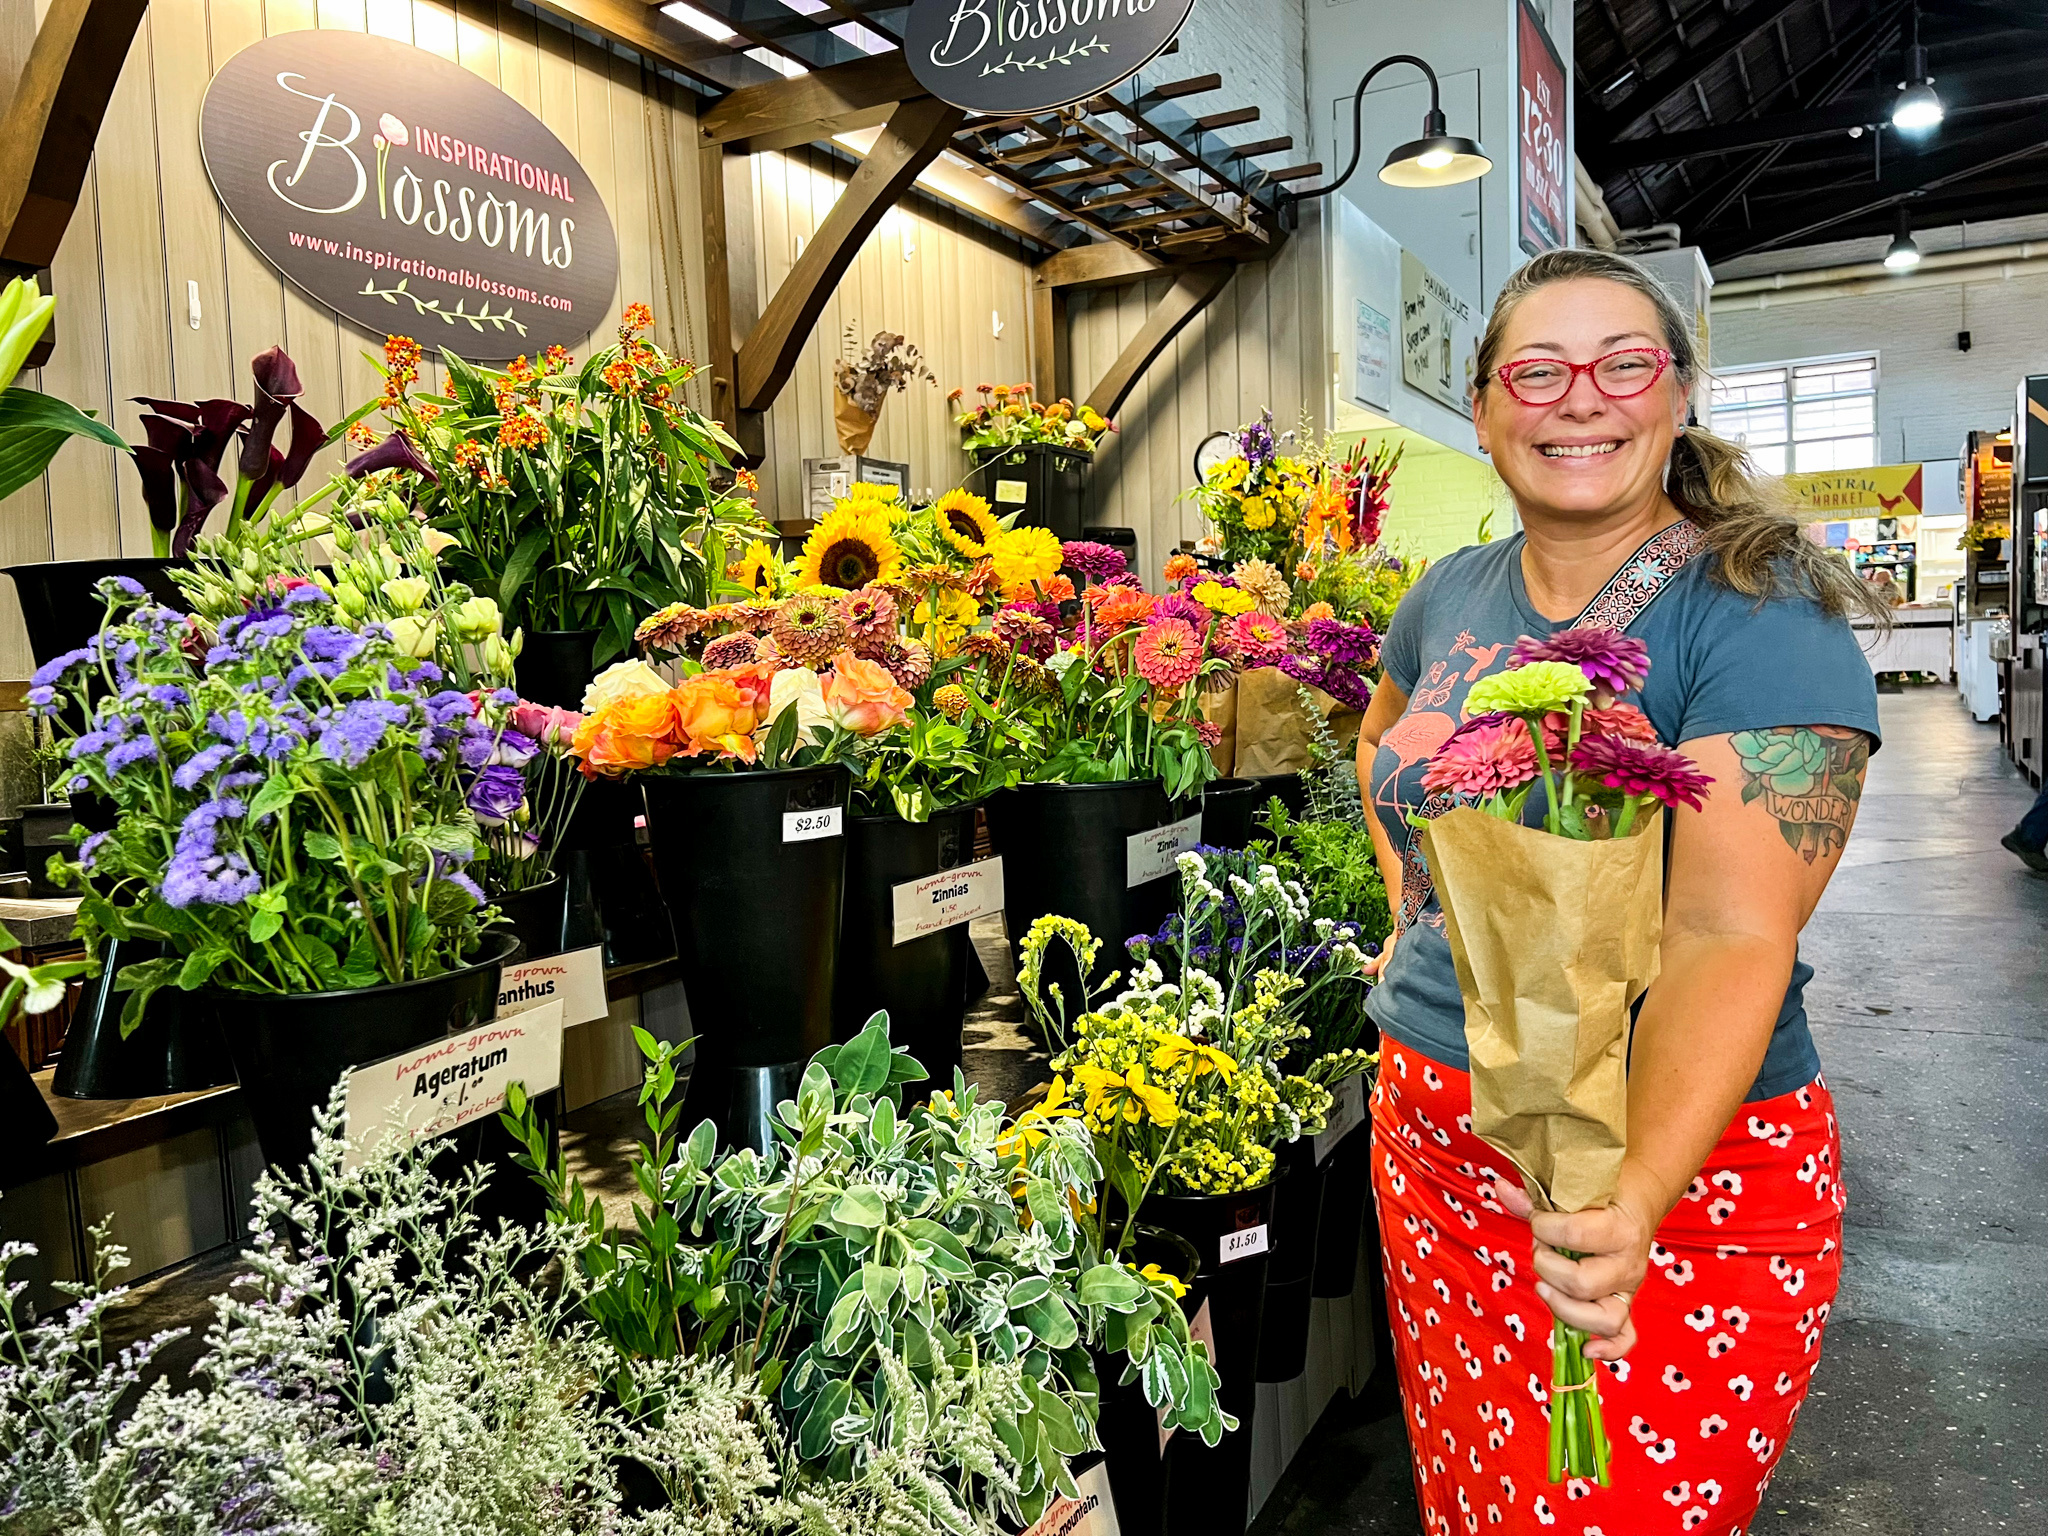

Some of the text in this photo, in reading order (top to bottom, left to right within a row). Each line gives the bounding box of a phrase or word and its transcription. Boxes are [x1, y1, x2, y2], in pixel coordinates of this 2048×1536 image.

[1521, 85, 1563, 187] 1730
[266, 71, 576, 269] Blossoms
[414, 125, 575, 203] INSPIRATIONAL
[288, 231, 572, 312] www.inspirationalblossoms.com
[1800, 478, 1877, 497] CENTRAL
[1812, 491, 1863, 507] MARKET
[1772, 794, 1850, 825] WONDER
[795, 814, 831, 834] $2.50
[1144, 826, 1189, 846] home-grown
[1157, 836, 1179, 853] Zinnia
[916, 870, 983, 895] home-grown
[931, 883, 969, 904] Zinnias
[915, 904, 982, 931] hand-picked
[503, 966, 568, 982] -grown
[498, 980, 555, 1006] anthus
[396, 1027, 526, 1081] home-grown
[412, 1047, 508, 1099] Ageratum
[1229, 1231, 1258, 1251] $1.50
